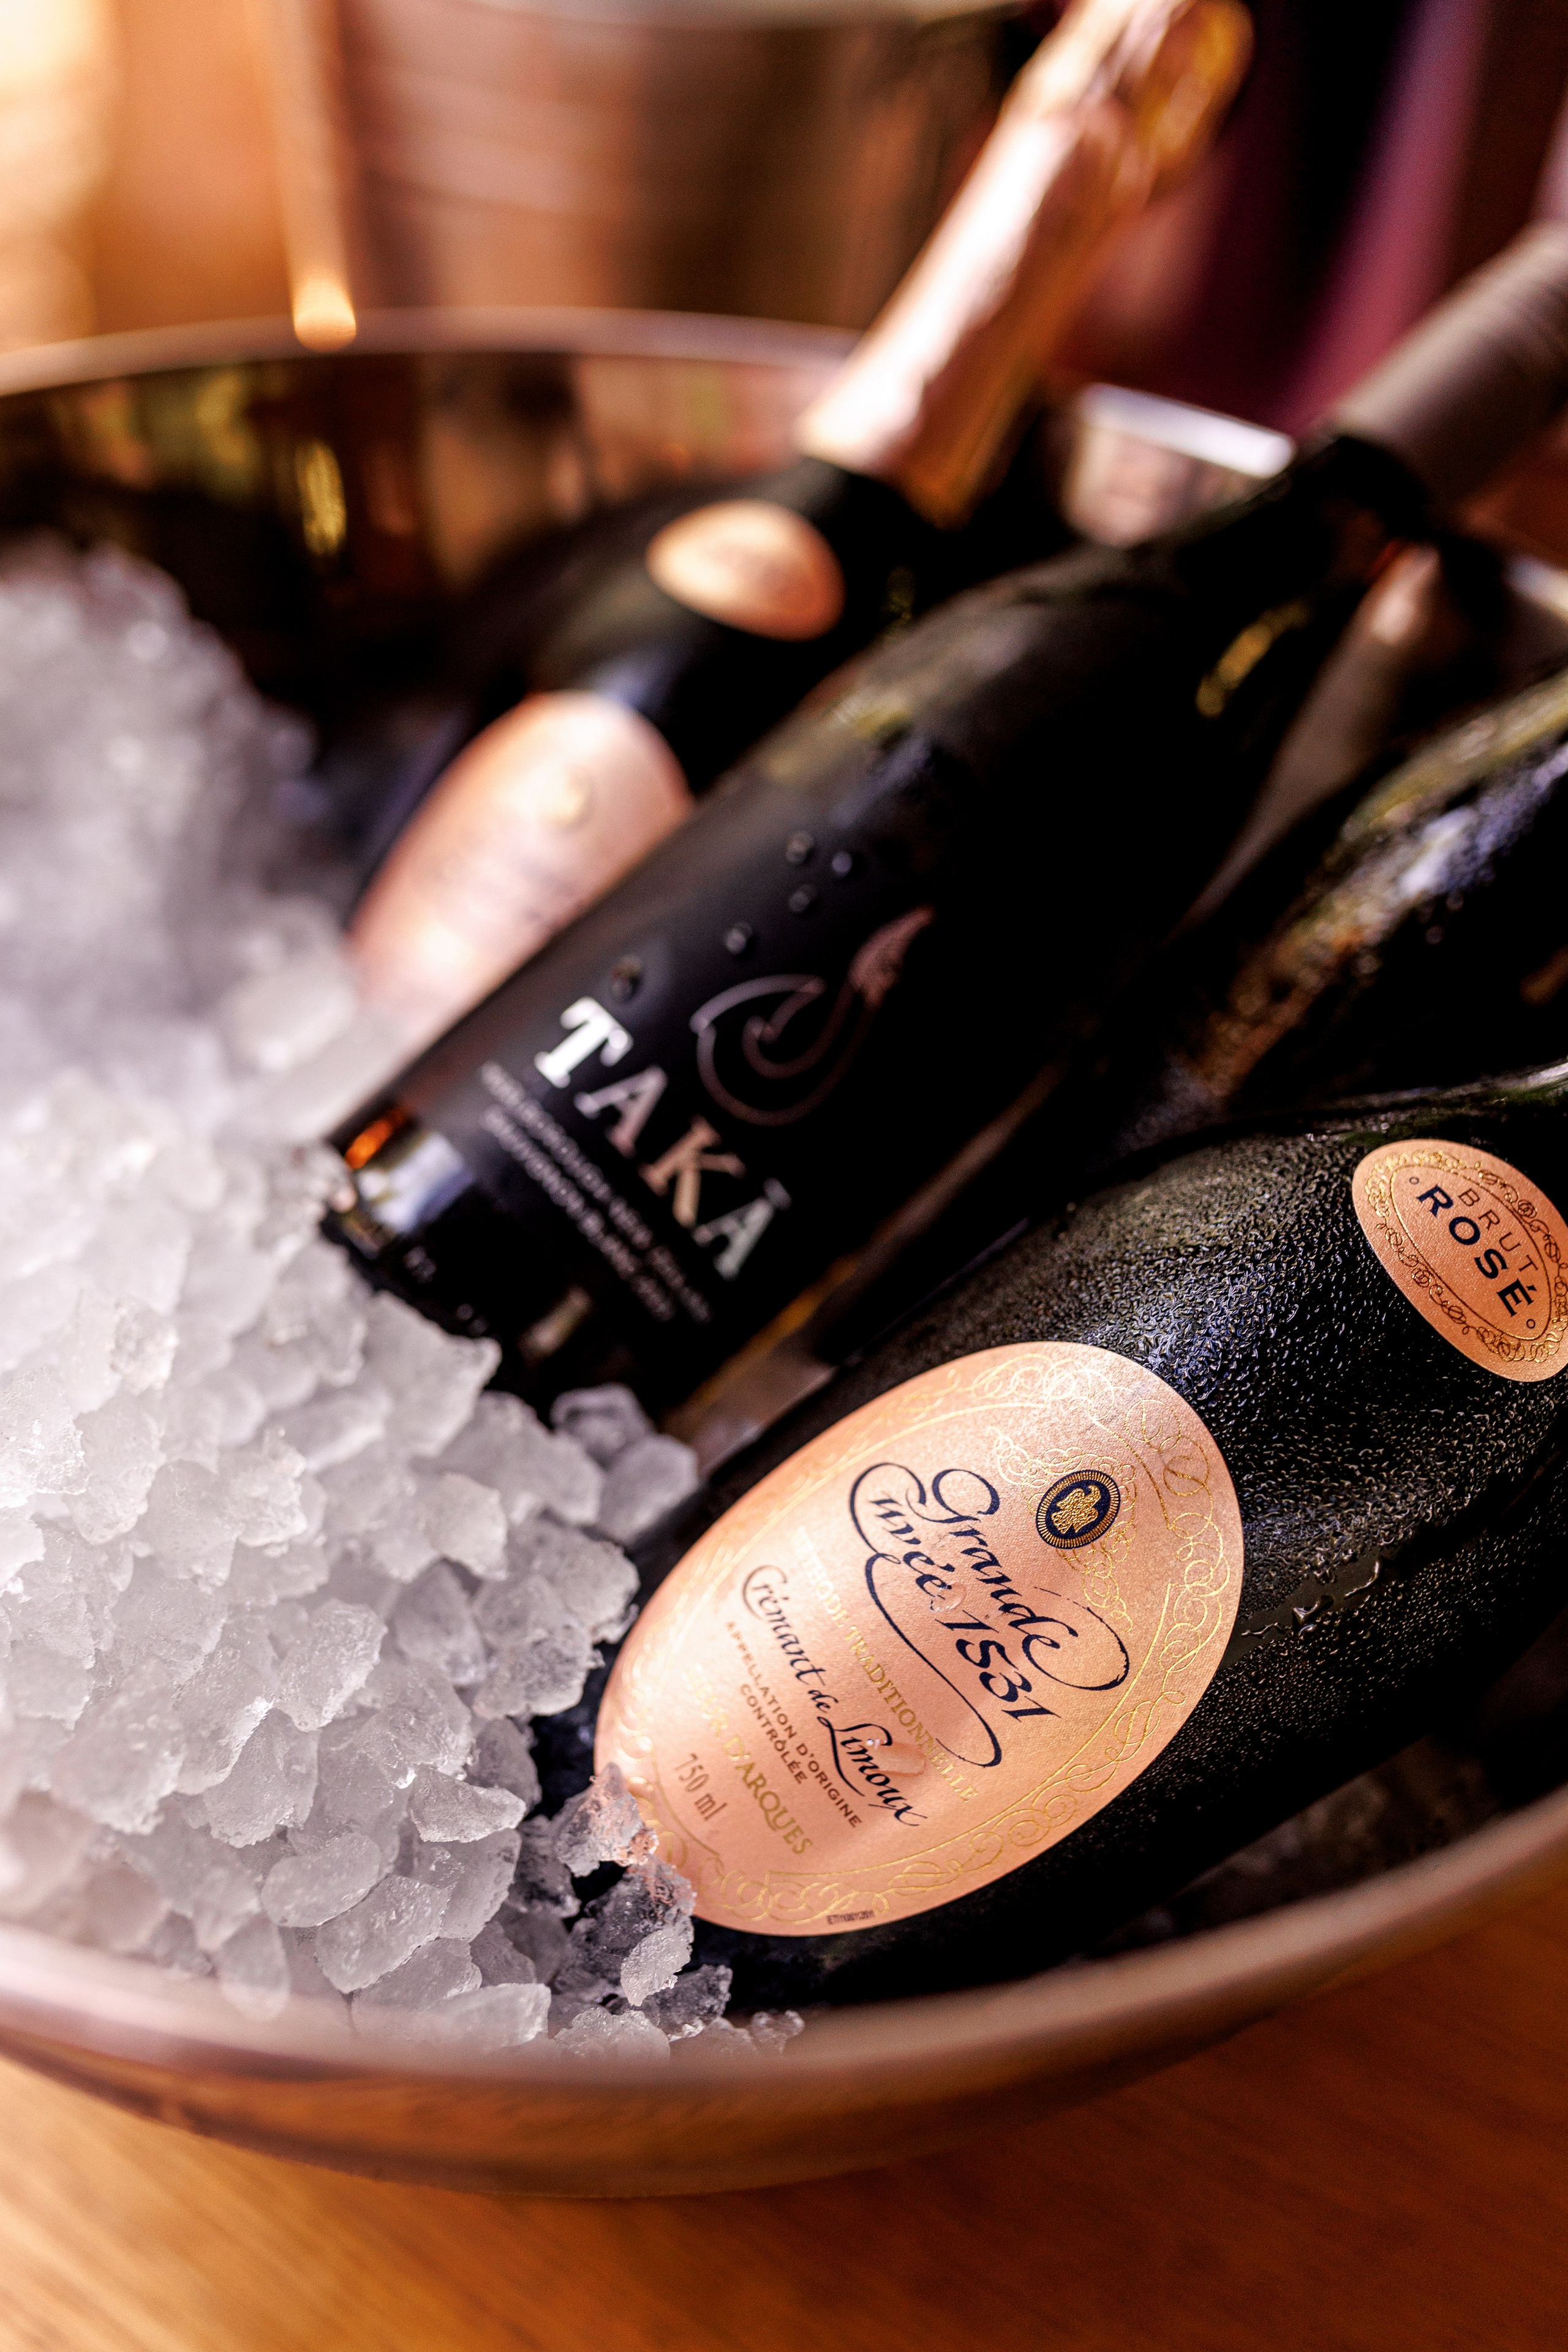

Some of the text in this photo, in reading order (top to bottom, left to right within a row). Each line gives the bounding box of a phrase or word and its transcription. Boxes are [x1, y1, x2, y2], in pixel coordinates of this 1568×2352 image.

[534, 997, 792, 1281] TAKA
[1417, 1185, 1537, 1318] ROSÉ
[1457, 1188, 1539, 1273] BRUT
[742, 1564, 826, 1687] Crémant
[906, 1468, 1129, 1691] Grande
[786, 1524, 853, 1629] THODE
[844, 1624, 979, 1804] TRADITIONNELLE
[807, 1688, 839, 1714] de
[935, 1610, 1062, 1723] 1531
[724, 1621, 798, 1741] APPELLATION
[797, 1744, 863, 1829] D'ORIGINE
[739, 1683, 809, 1785] CONTRÔLÉE
[816, 1715, 929, 1827] Limoux
[673, 1752, 729, 1822] 750 ml
[722, 1736, 813, 1856] D'ARQUES
